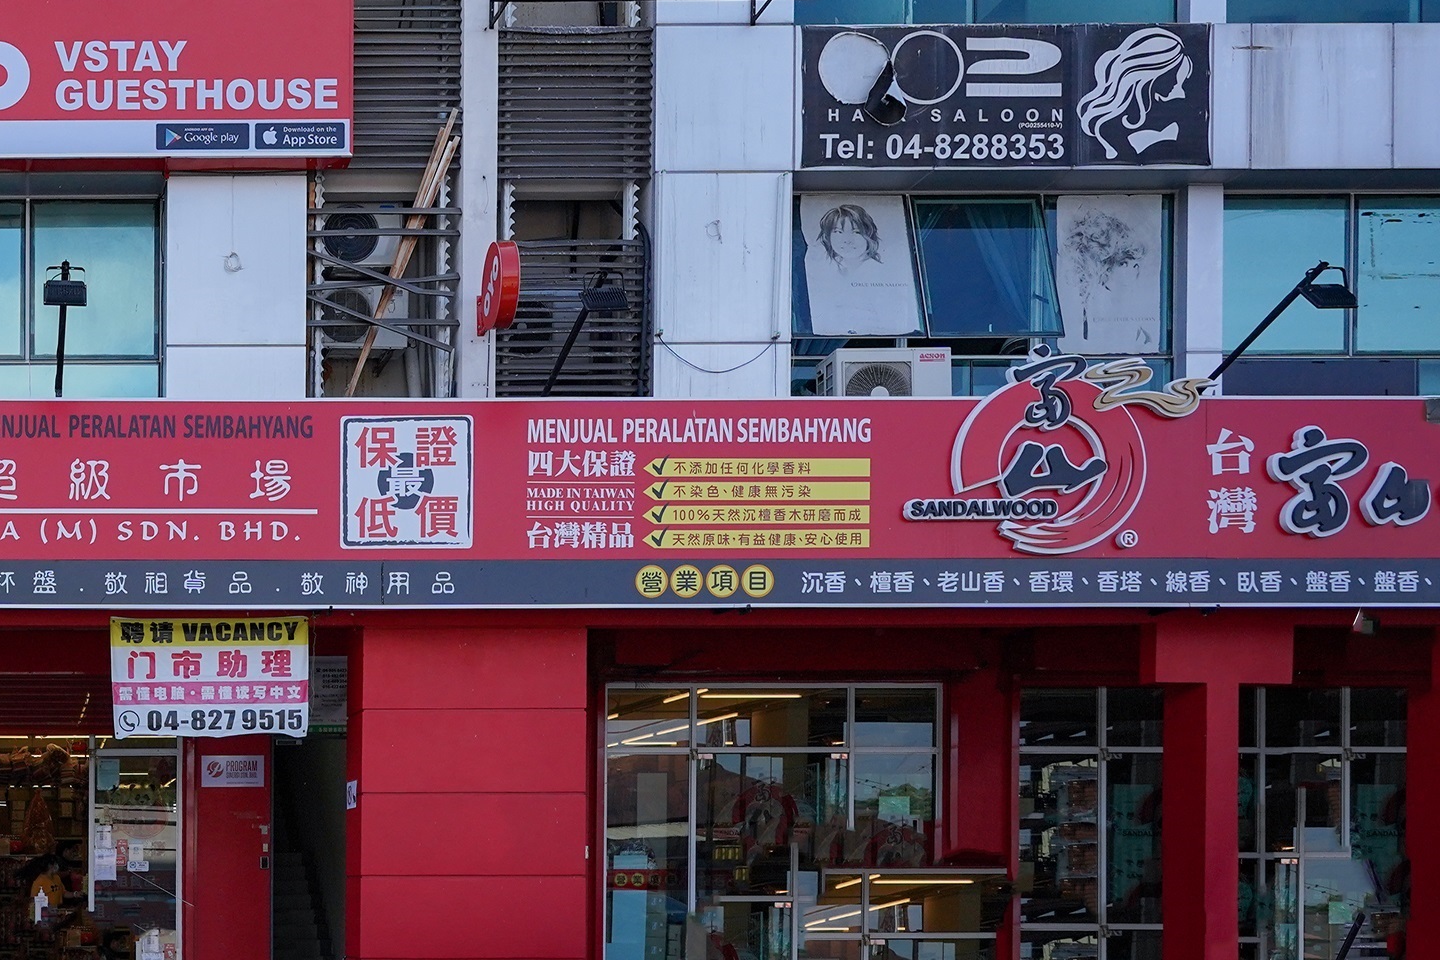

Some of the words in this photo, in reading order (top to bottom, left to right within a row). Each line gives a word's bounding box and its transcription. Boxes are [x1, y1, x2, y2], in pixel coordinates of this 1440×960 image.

[54, 41, 188, 72] VSTAY
[54, 78, 338, 111] GUESTHOUSE
[931, 108, 1064, 122] SALOON
[184, 132, 218, 145] Google
[220, 133, 240, 144] play
[283, 135, 305, 147] App
[307, 134, 338, 145] Store
[819, 134, 874, 159] Tel:
[886, 133, 1065, 160] 04-8288353
[68, 414, 177, 439] PERALATAN
[182, 414, 314, 439] SEMBAHYANG
[527, 419, 618, 443] MENJUAL
[622, 418, 734, 443] PERALATAN
[737, 418, 871, 443] SEMBAHYANG
[354, 426, 458, 469] 保證
[527, 450, 636, 477] 四大保證
[673, 461, 812, 475] 不添加任何化學香料
[386, 465, 426, 498] 最
[673, 485, 812, 499] 不染色、健康無污染
[1207, 427, 1257, 533] 台灣
[526, 487, 564, 499] MADE
[566, 487, 582, 499] IN
[584, 487, 636, 499] TAIWAN
[354, 495, 459, 539] 低價
[526, 500, 566, 512] HIGH
[569, 500, 635, 513] QUALITY
[910, 500, 1057, 517] SANDALWOOD
[39, 518, 98, 544] (M)
[117, 518, 200, 541] SDN.
[219, 518, 302, 541] BHD.
[526, 521, 634, 549] 台灣精品
[104, 570, 253, 596] 敬祖貨品
[300, 570, 456, 596] 敬神用品
[641, 571, 768, 594] 營業項目
[120, 622, 174, 644] 聘请
[182, 622, 299, 642] VACANCY
[127, 649, 293, 680] 门市助理
[119, 686, 185, 701] 需懂电脑
[201, 685, 301, 700] 需懂读写中文
[147, 709, 236, 730] 04-827
[241, 709, 302, 730] 9515
[226, 760, 258, 772] PROGRAM
